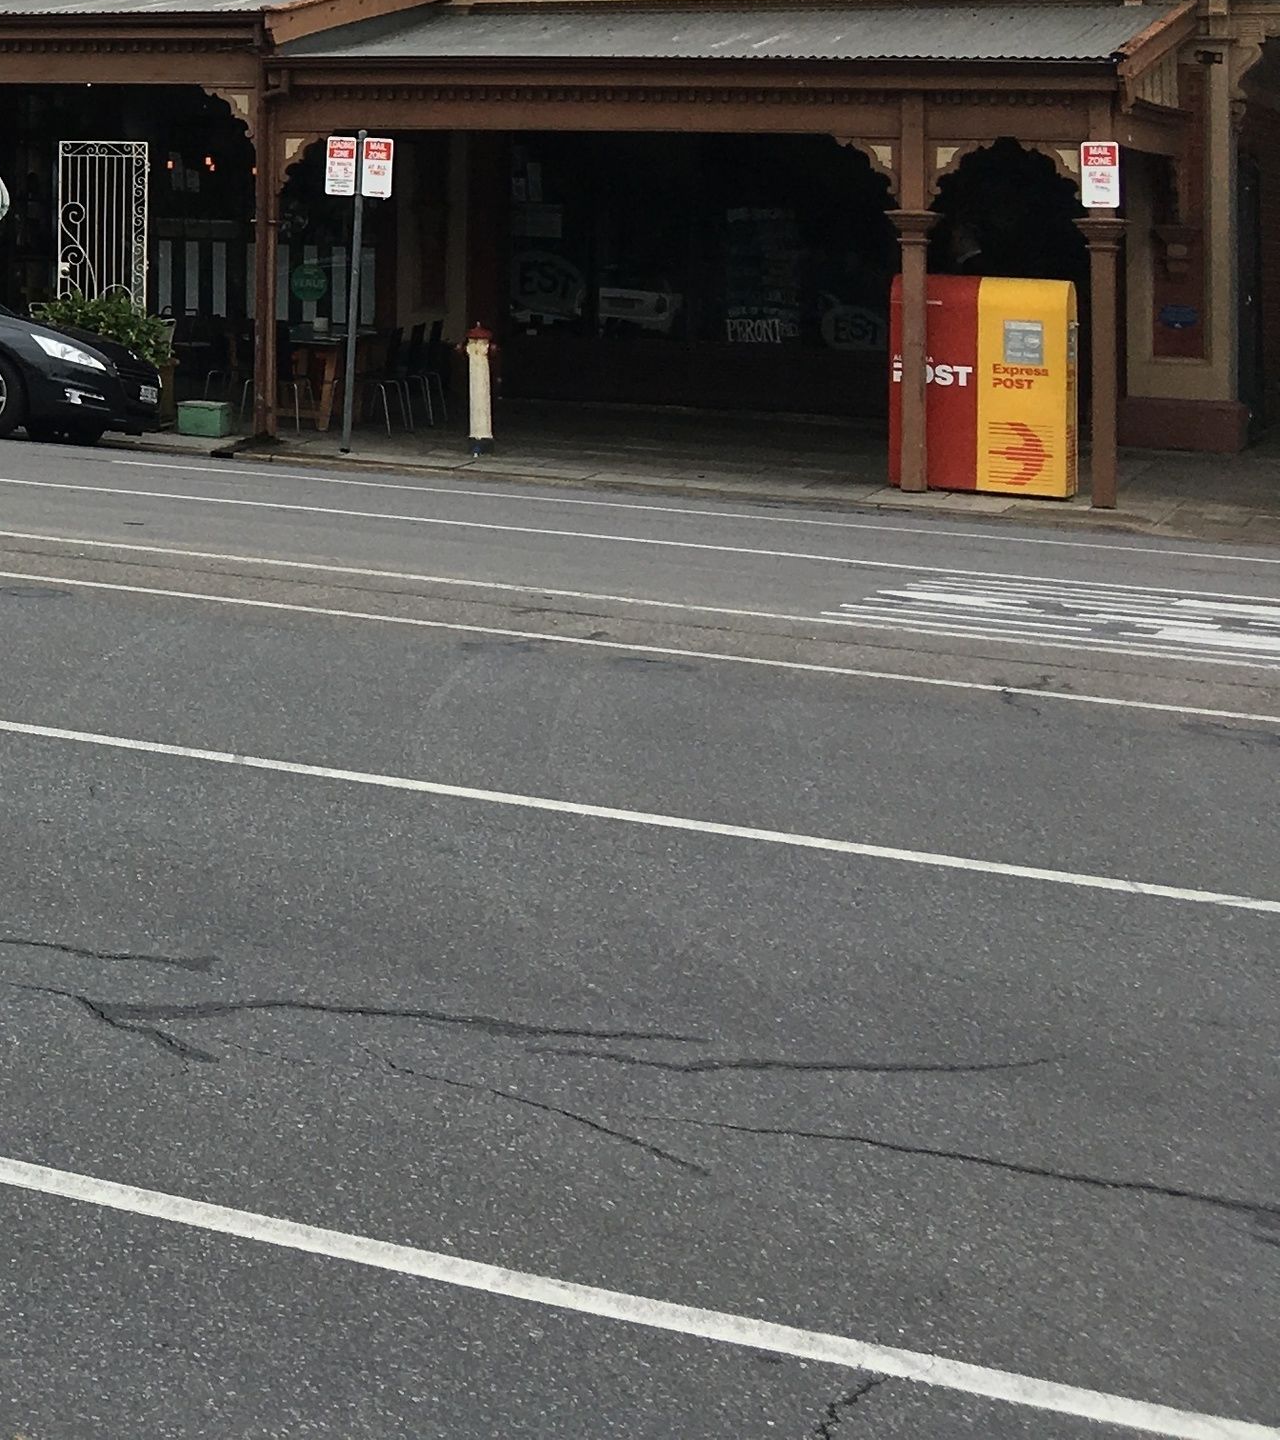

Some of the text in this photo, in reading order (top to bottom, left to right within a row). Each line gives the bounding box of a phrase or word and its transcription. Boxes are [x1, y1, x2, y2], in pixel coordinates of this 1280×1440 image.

[369, 142, 387, 151] MAIL
[1089, 146, 1111, 155] MAIL
[367, 150, 388, 160] ZONE
[1088, 156, 1113, 165] ZONE
[992, 363, 1049, 377] Express
[992, 377, 1035, 390] POST
